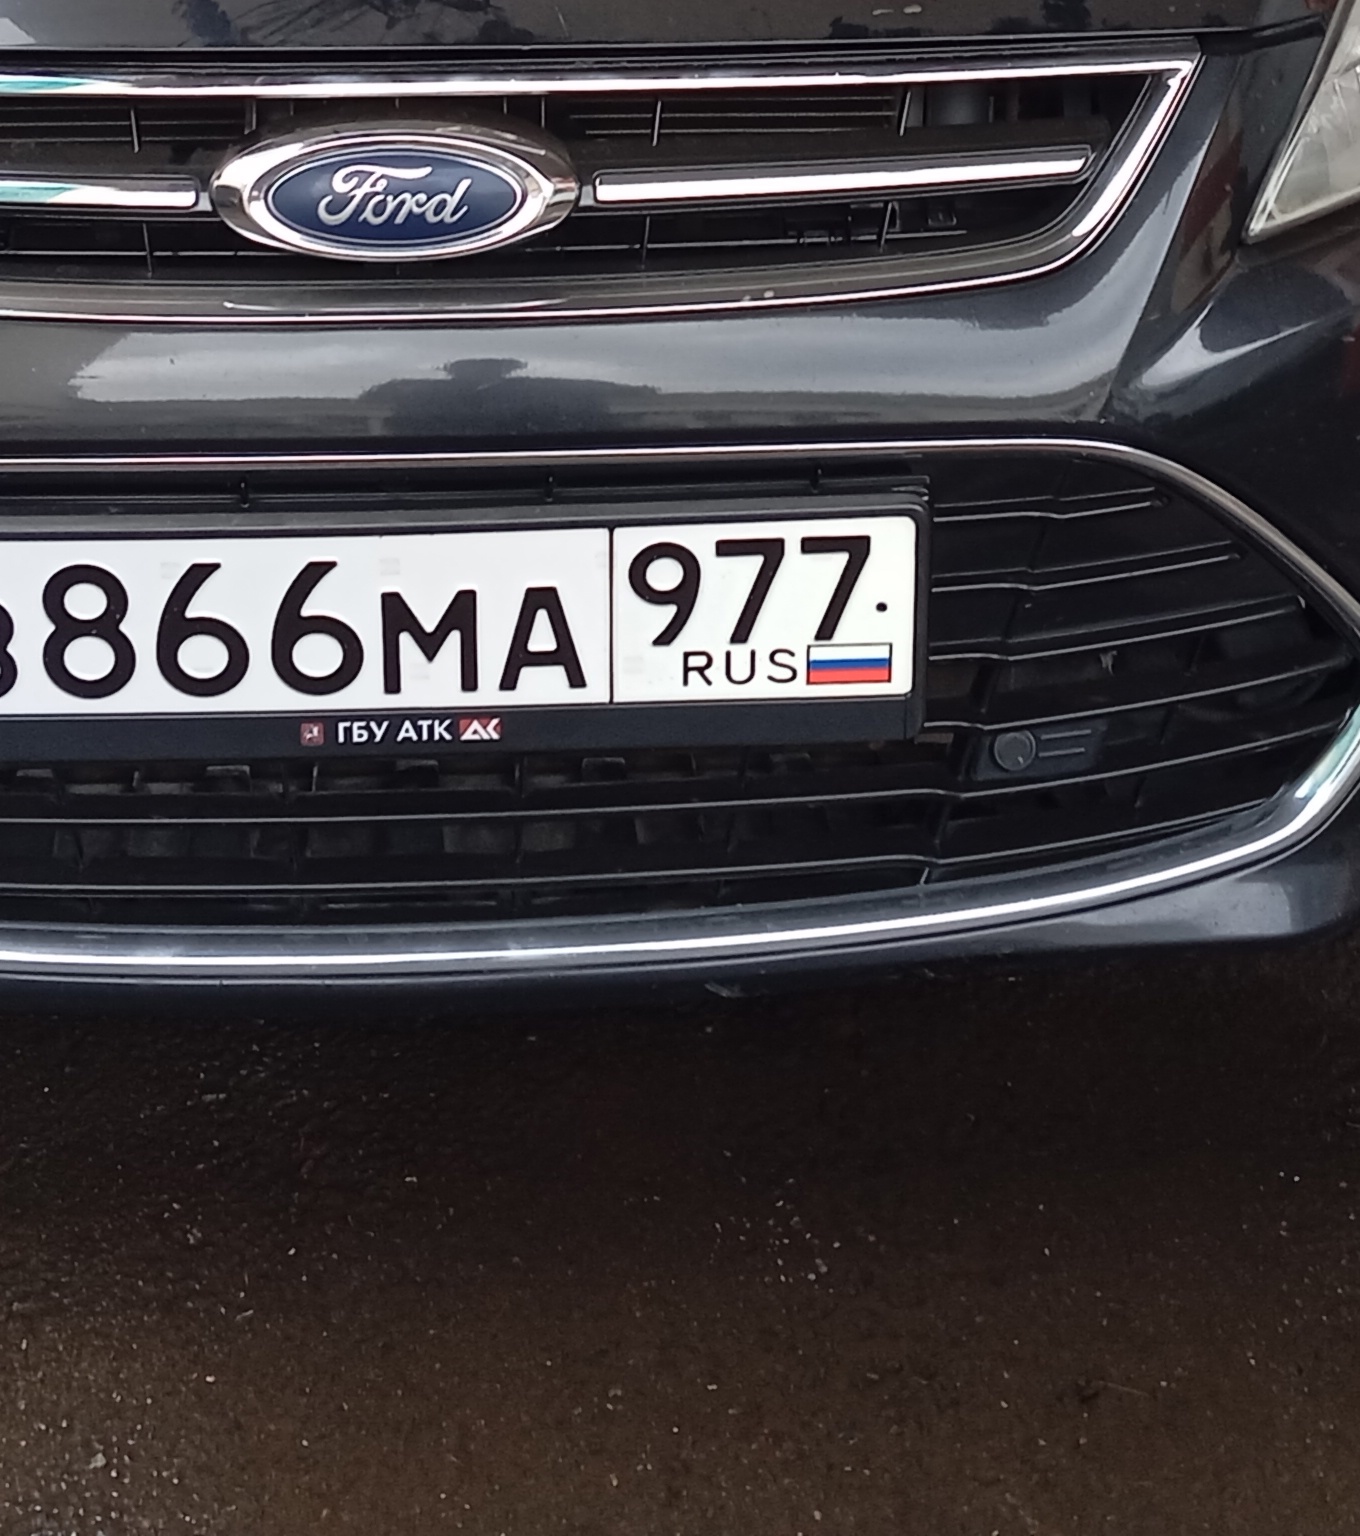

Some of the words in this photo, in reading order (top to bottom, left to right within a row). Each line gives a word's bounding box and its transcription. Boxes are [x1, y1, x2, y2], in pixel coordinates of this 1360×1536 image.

[317, 164, 472, 226] Ford
[628, 535, 873, 647] 977
[682, 648, 798, 686] RUS
[337, 720, 389, 743] ГБУ
[396, 718, 453, 741] АТК
